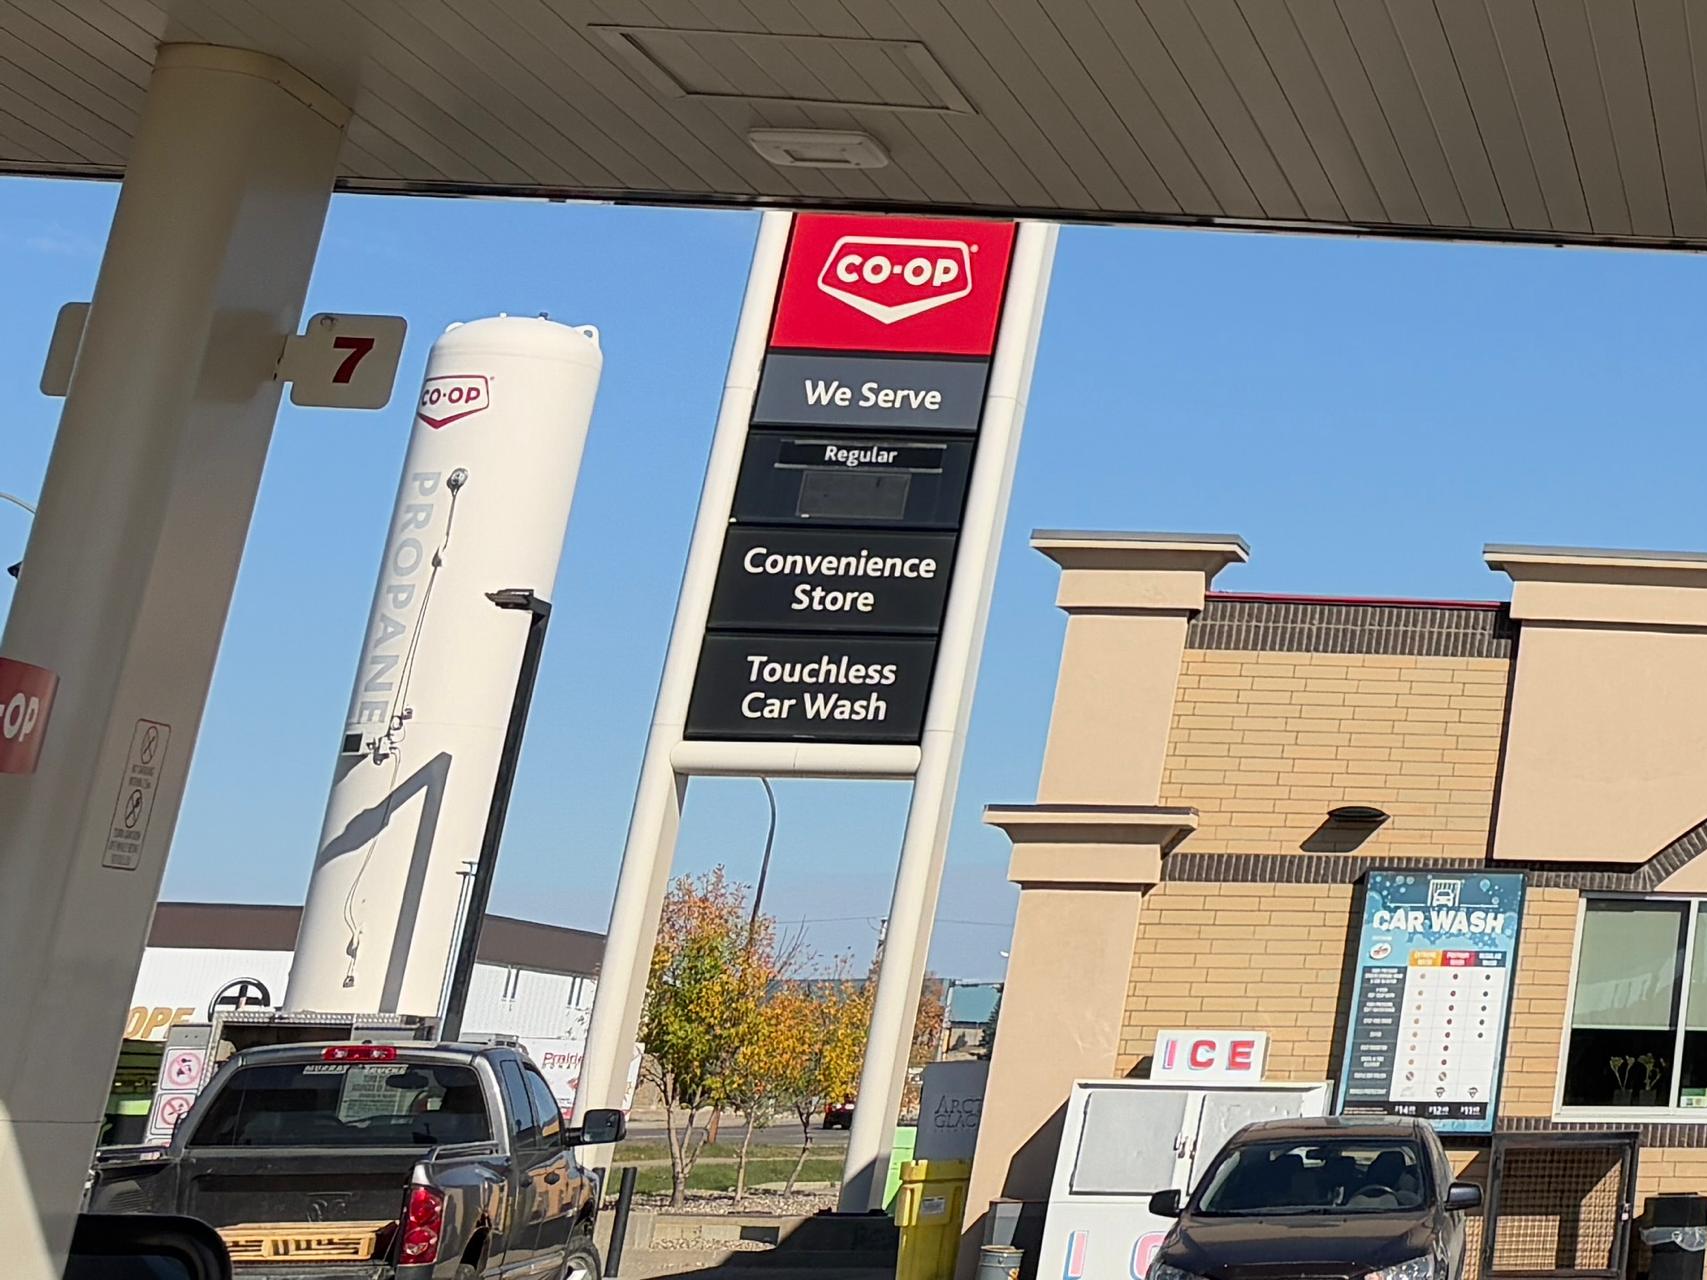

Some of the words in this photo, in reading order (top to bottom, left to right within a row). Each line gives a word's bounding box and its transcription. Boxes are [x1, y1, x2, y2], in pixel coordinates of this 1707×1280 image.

[836, 254, 958, 287] CO-OP
[332, 336, 375, 384] 7
[805, 379, 852, 406] We
[858, 382, 942, 410] Serve
[824, 445, 898, 467] Regular
[743, 547, 937, 578] Convenience
[357, 471, 442, 724] PROPANE
[791, 583, 875, 612] Store
[746, 655, 897, 685] Touchless
[741, 691, 796, 718] Car
[803, 692, 887, 721] Wash
[1372, 910, 1425, 932] CAR
[1430, 910, 1505, 934] WASH
[1163, 1040, 1255, 1071] ICE
